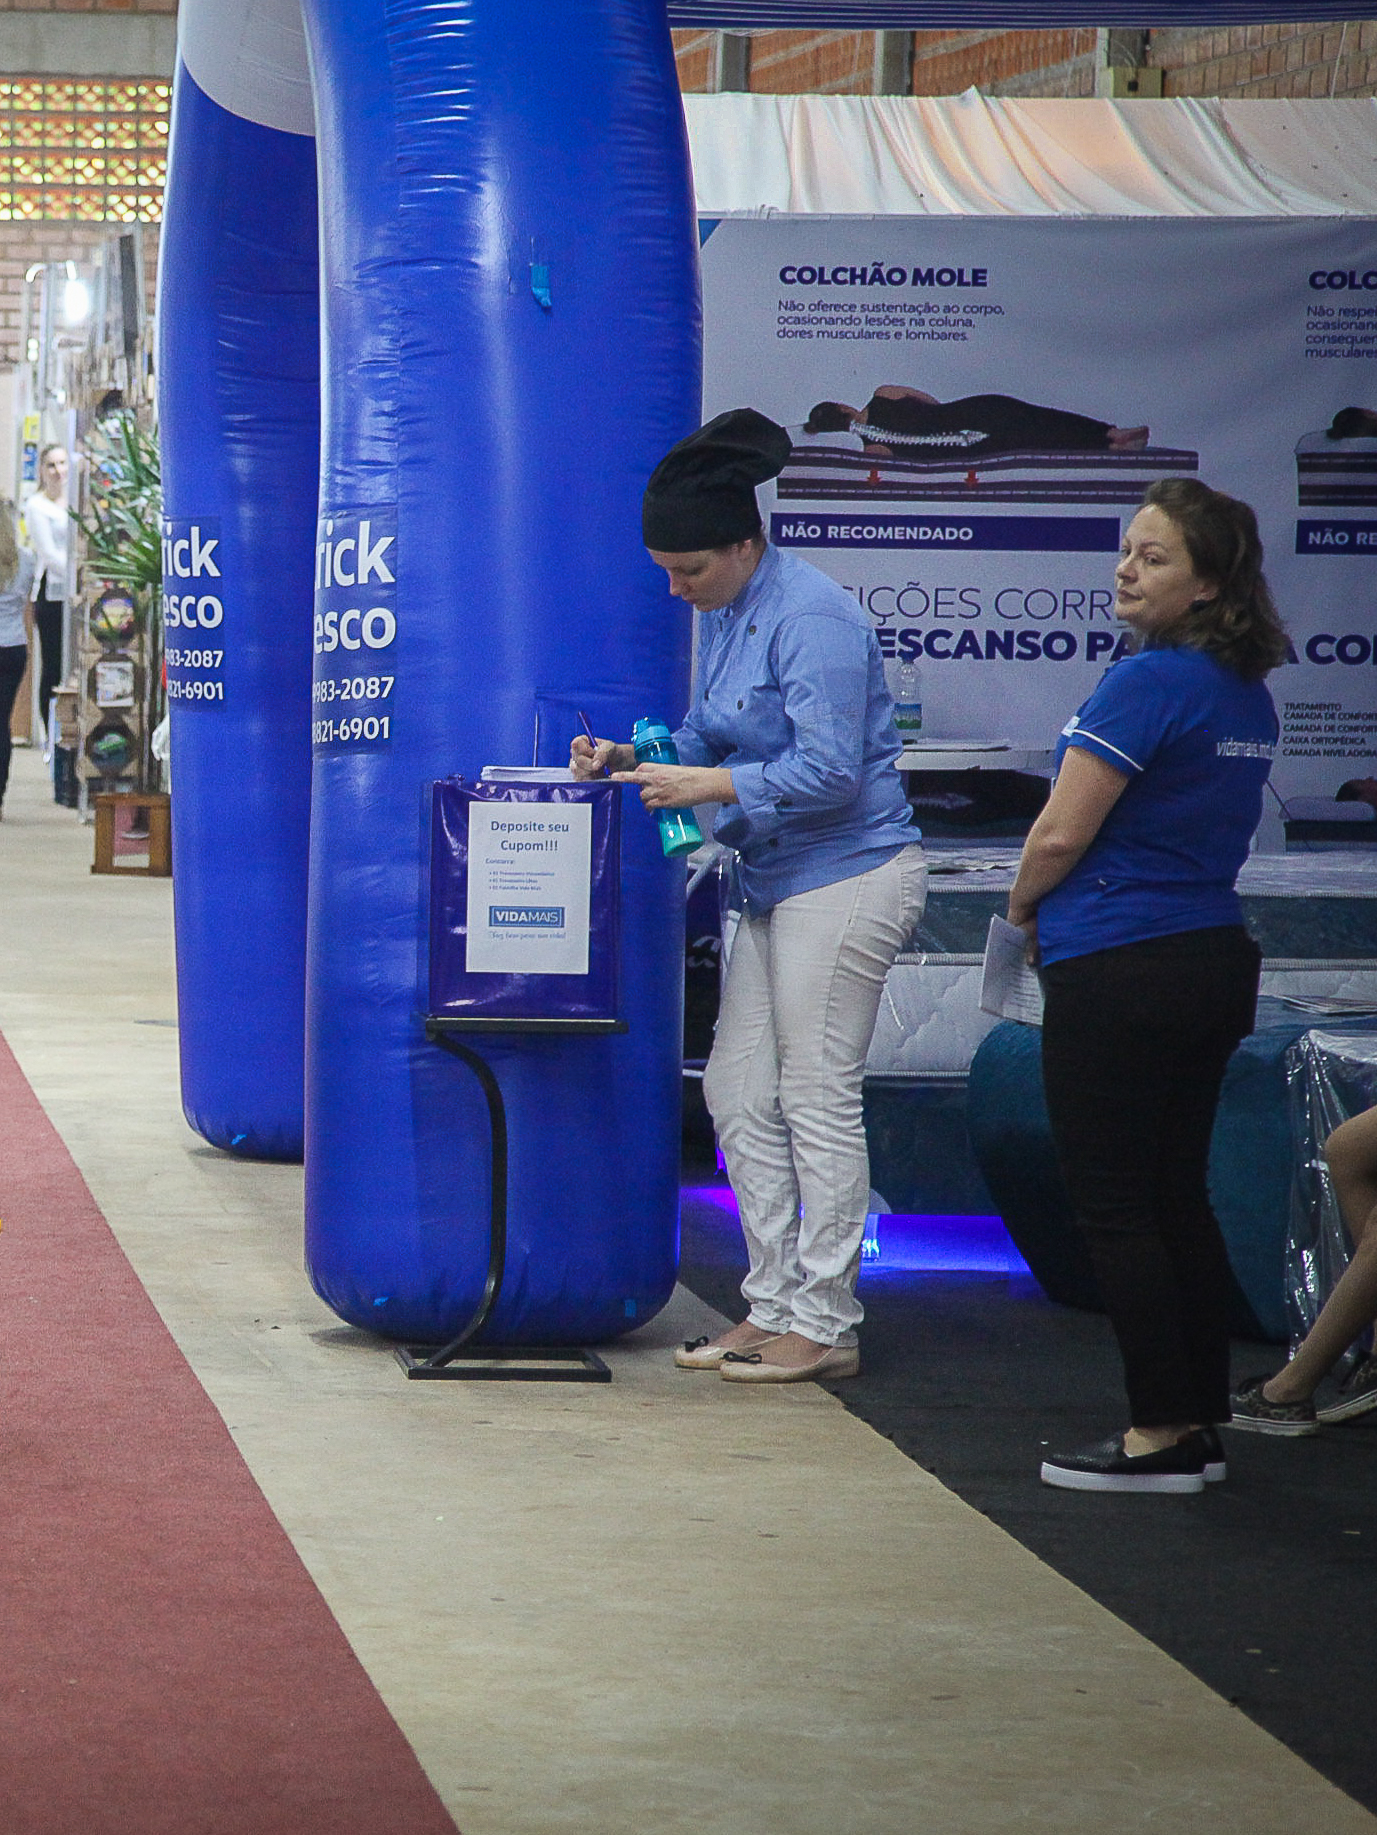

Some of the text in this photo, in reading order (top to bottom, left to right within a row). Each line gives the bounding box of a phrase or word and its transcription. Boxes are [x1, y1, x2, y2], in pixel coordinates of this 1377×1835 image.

[779, 262, 988, 287] COLCHÃO MOLE
[1309, 270, 1377, 290] COLC
[778, 301, 1005, 316] Não oferece sustentação ao corpo,
[1307, 305, 1335, 317] Não
[777, 315, 976, 329] ocasionando lesões na coluna,
[777, 328, 814, 339] dores
[817, 329, 891, 340] musculares
[894, 331, 902, 340] e
[781, 521, 973, 540] NÃO RECOMENDADO
[1308, 528, 1377, 545] NÃO RE
[315, 518, 395, 590] rick
[843, 582, 1113, 626] IÇÕES CORR
[314, 607, 396, 654] esco
[1305, 633, 1377, 666] CO
[1285, 703, 1342, 711] TRATAMENTO
[491, 821, 569, 834] Deposite seu
[500, 840, 558, 853] Cupom!!!
[495, 910, 559, 923] VIDAMAIS
